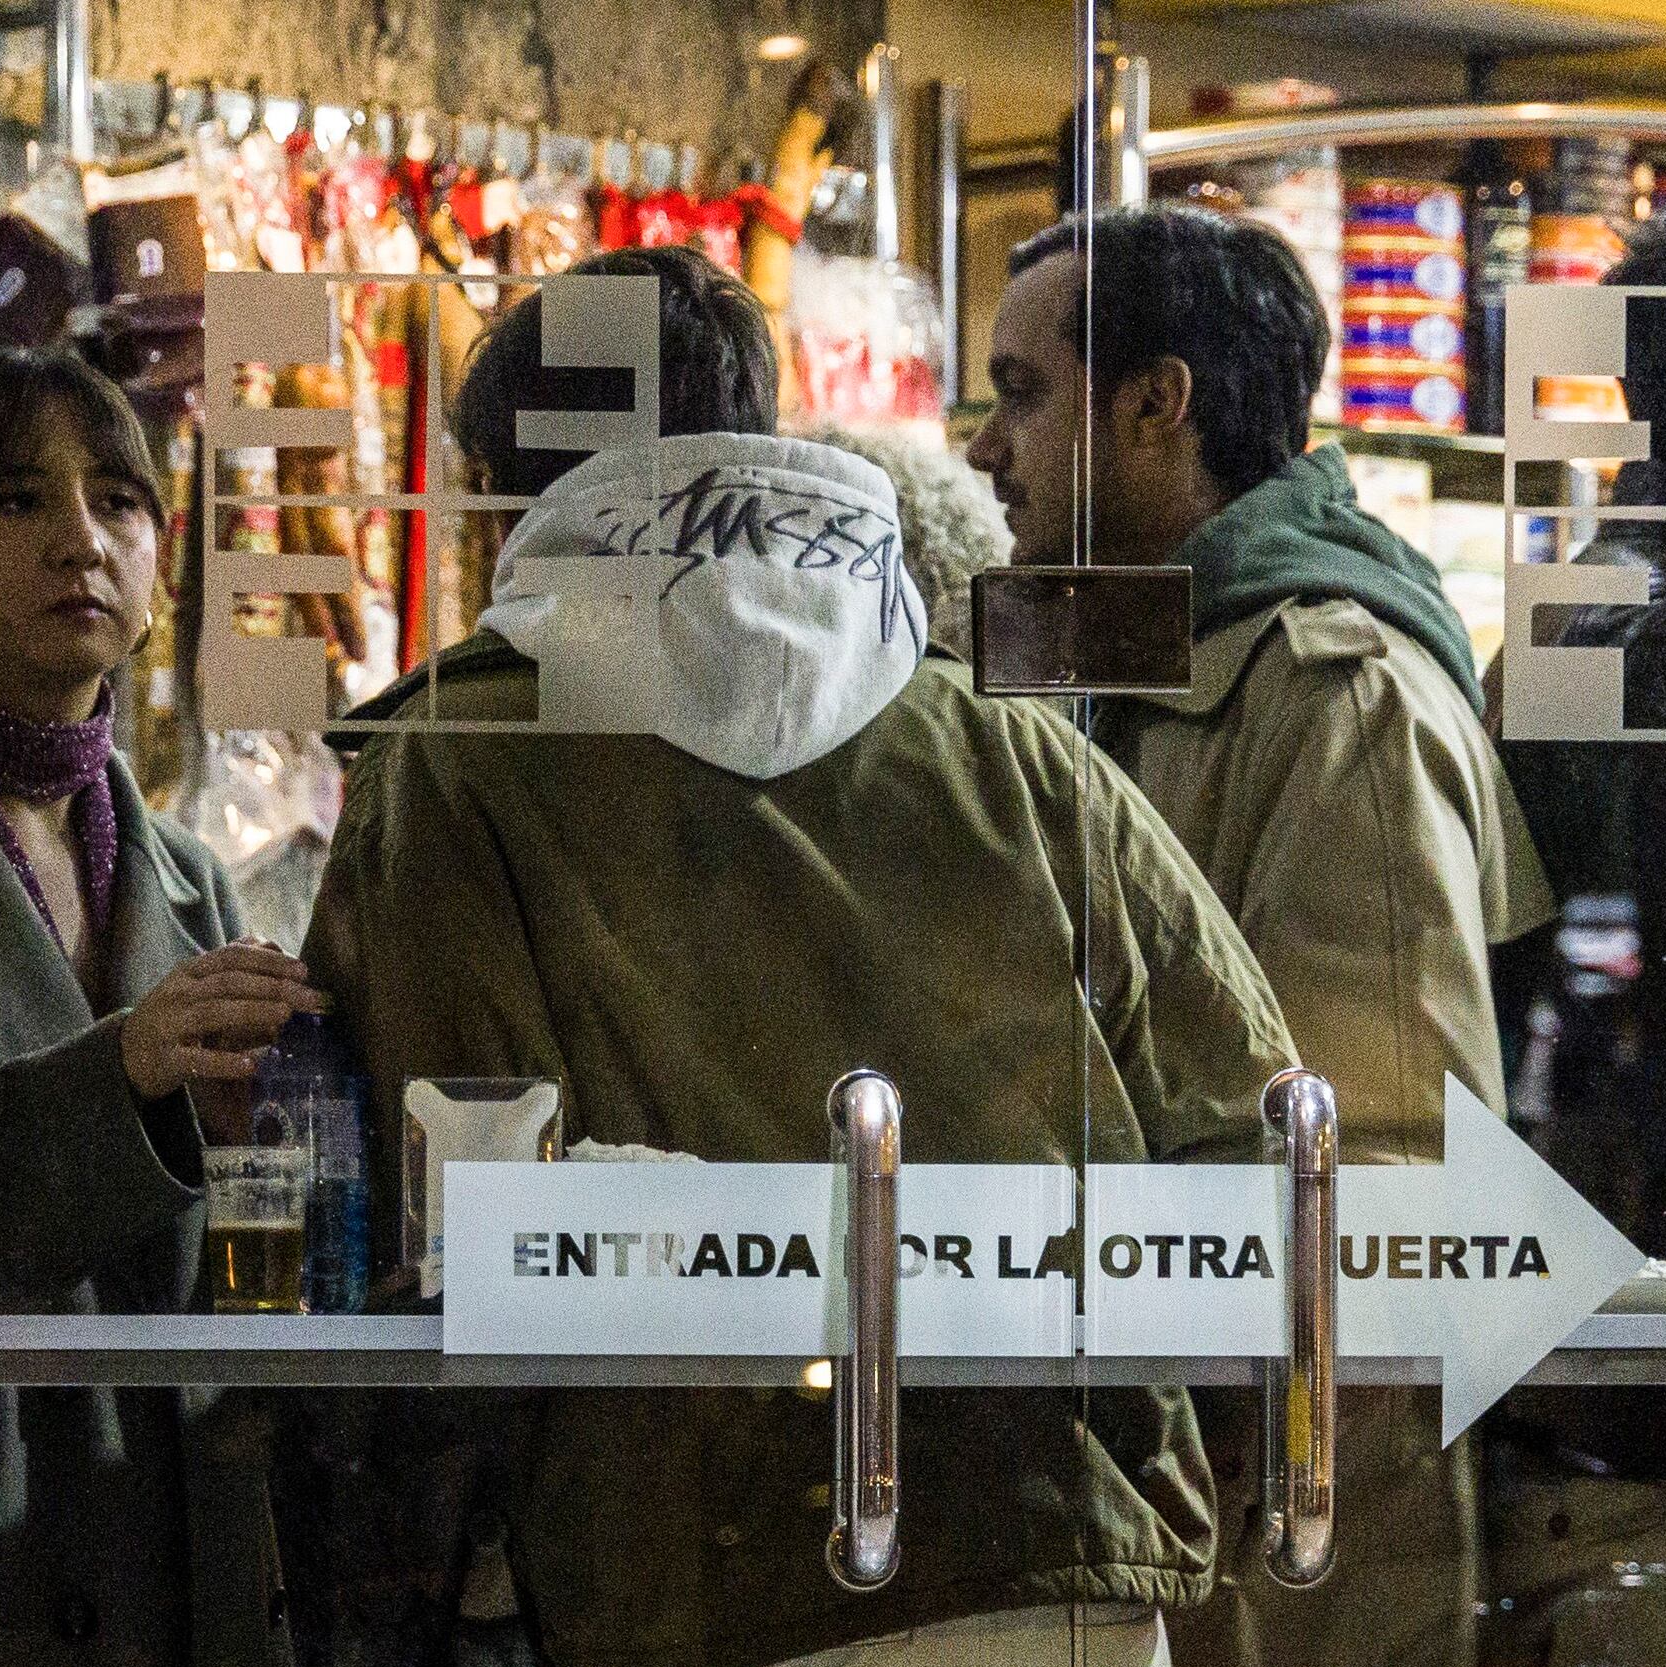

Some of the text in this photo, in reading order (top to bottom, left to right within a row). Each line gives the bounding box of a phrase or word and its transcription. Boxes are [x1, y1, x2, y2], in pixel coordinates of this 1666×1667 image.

[513, 1232, 1551, 1280] ENTRADA OR LA OTRA UERTA
